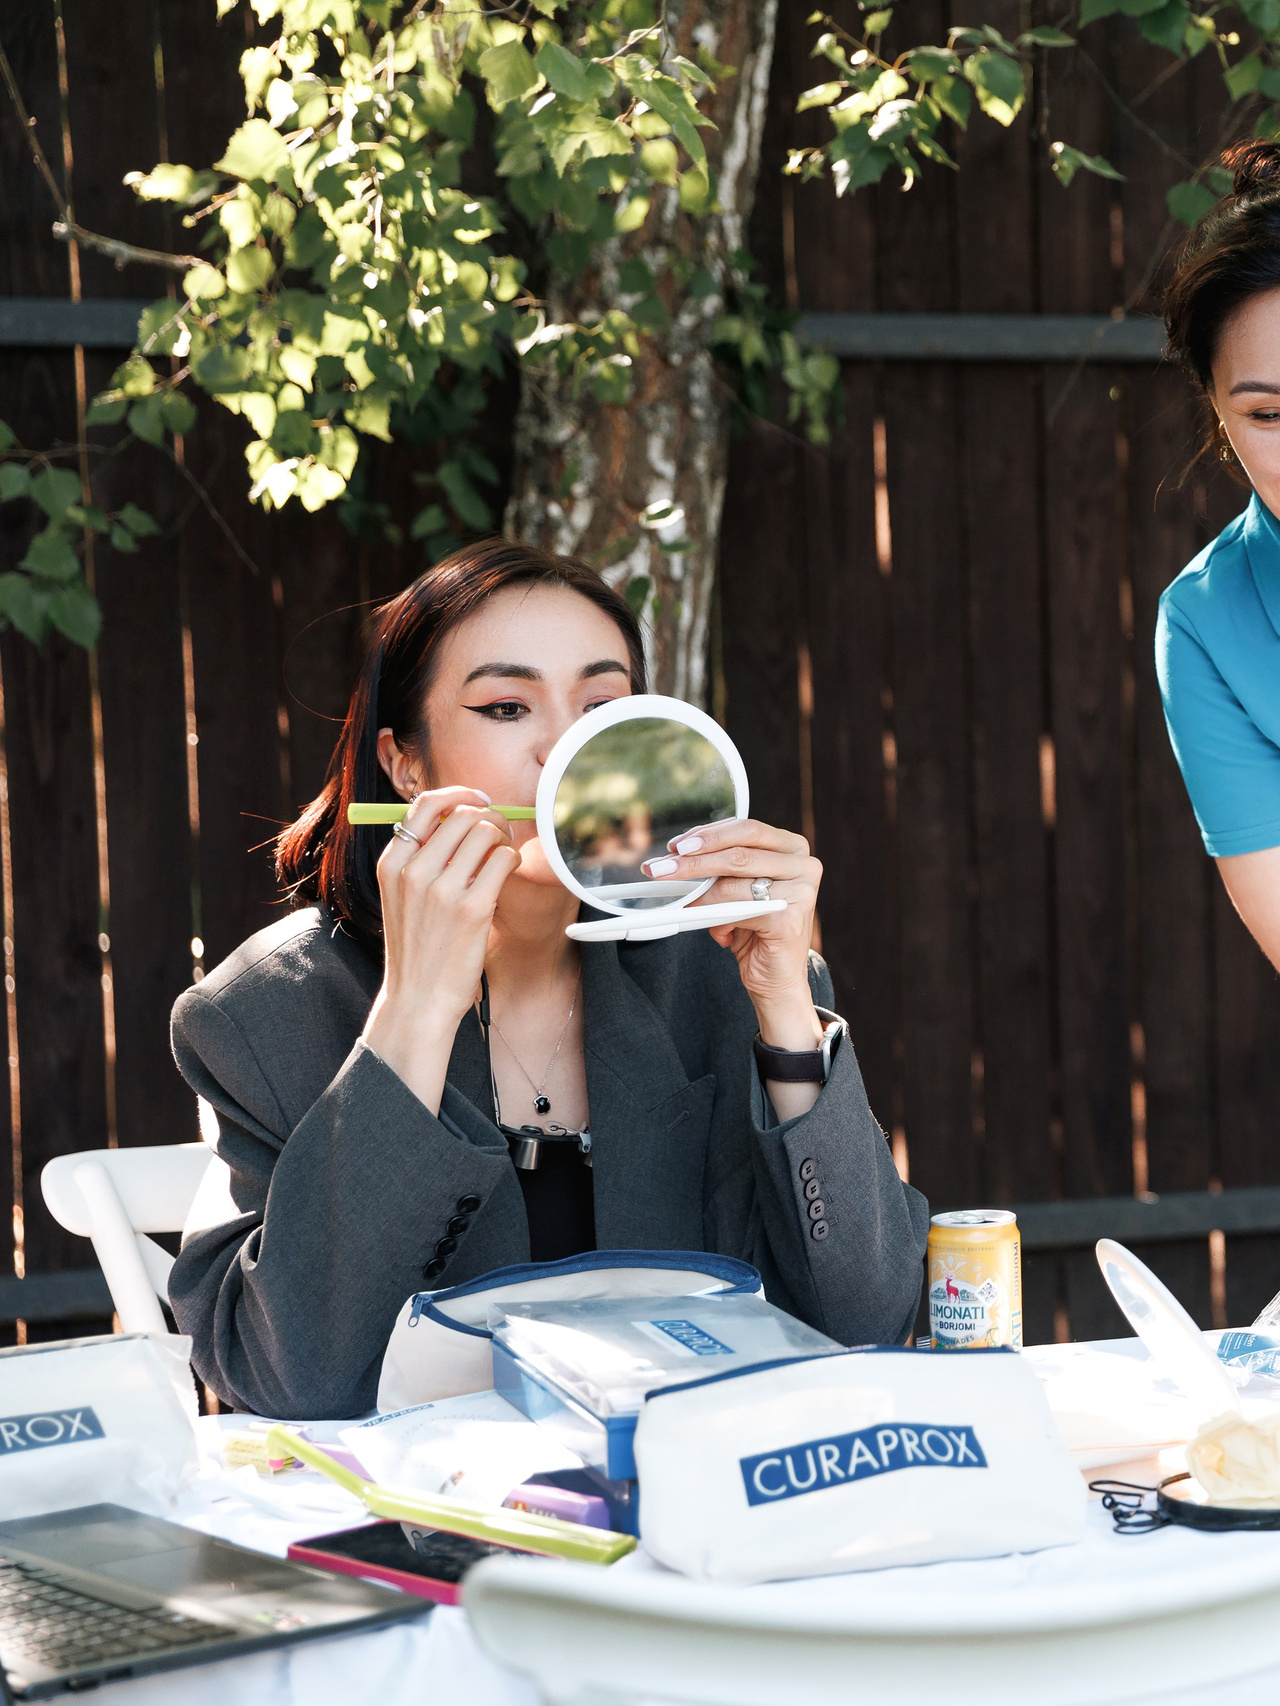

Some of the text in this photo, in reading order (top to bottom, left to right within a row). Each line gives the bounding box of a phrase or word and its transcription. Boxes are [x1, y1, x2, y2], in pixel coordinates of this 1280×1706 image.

[930, 1302, 985, 1320] LIMONATI
[657, 1320, 728, 1355] CURAPROX
[935, 1331, 976, 1345] LEMONADES
[939, 1320, 976, 1331] BORJOMI
[0, 1411, 93, 1449] ROX
[752, 1427, 979, 1497] CURAPROX
